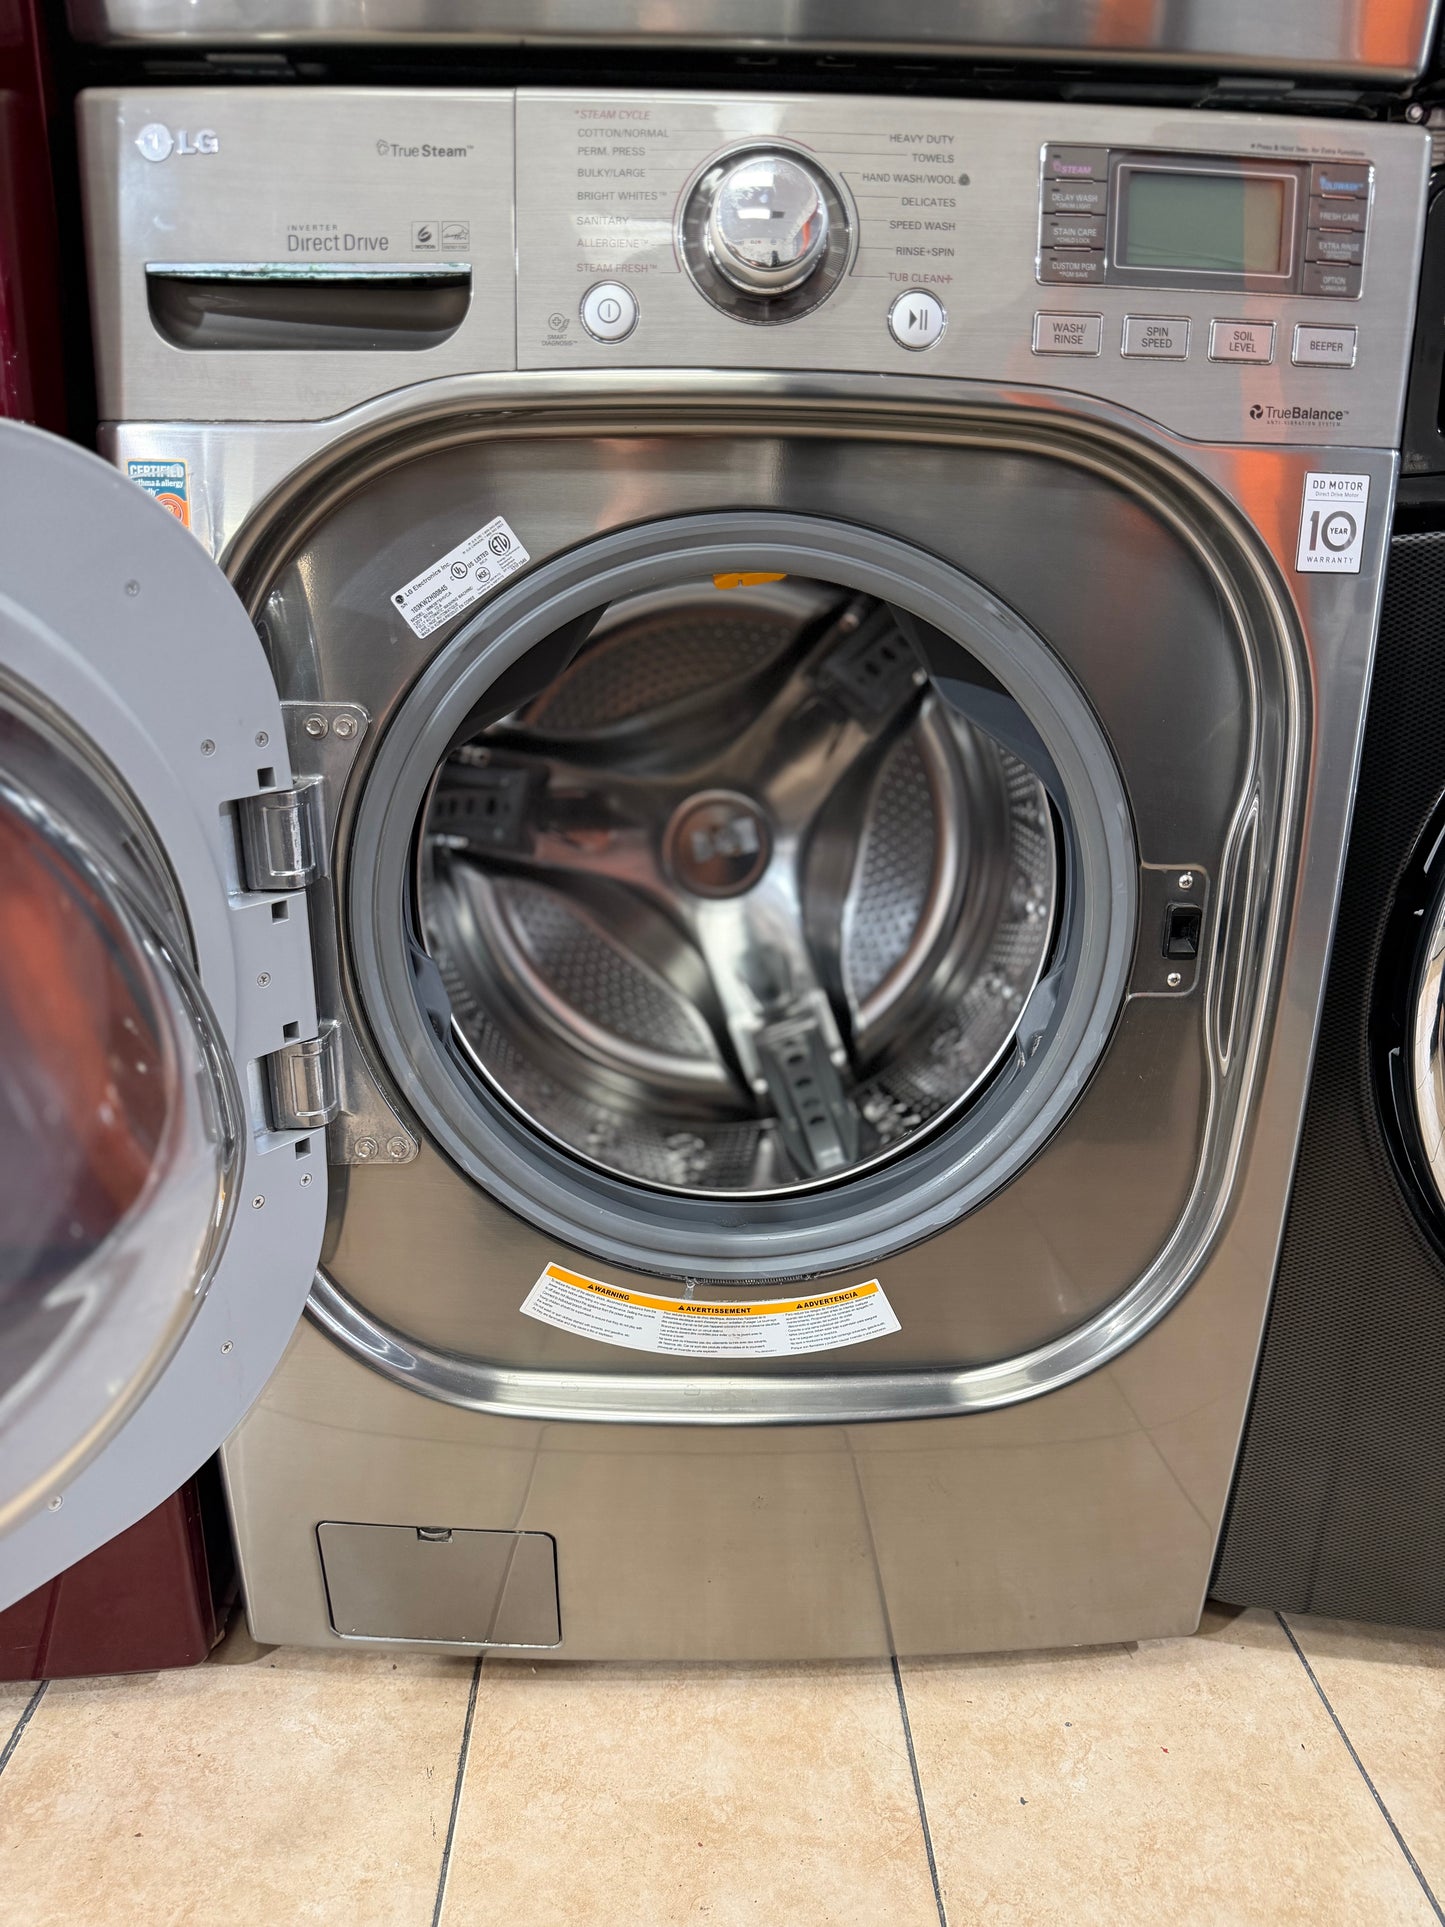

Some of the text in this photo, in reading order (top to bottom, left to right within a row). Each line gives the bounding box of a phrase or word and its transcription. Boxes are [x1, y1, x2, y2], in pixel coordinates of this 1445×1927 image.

[618, 110, 651, 120] CYCLE
[578, 128, 670, 138] COTTON/NORMAL
[178, 129, 219, 154] LG
[889, 134, 956, 144] HEAVY DUTY
[578, 146, 646, 156] PERM. PRESS
[912, 153, 955, 164] TOWELS
[577, 168, 646, 178] BULKY/LARGE
[862, 172, 956, 184] HAND WASH/WOOL
[577, 191, 616, 201] BRIGHT
[1052, 193, 1098, 202] DELAY WASH
[901, 197, 956, 208] DELICATES
[576, 216, 630, 225] SANITARY
[889, 220, 956, 231] SPEED WASH
[1054, 227, 1097, 237] STAIN CARE
[288, 234, 390, 251] Direct Drive
[896, 246, 955, 257] RINSE+SPIN
[576, 262, 612, 272] STEAM
[1052, 262, 1080, 270] CUSTOM
[888, 272, 909, 282] TUB
[1053, 322, 1086, 332] WASH/
[1146, 326, 1169, 336] SPIN
[1054, 334, 1084, 345] RINSE
[1233, 330, 1254, 342] SOIL
[1141, 338, 1172, 348] SPEED
[1229, 342, 1256, 353] LEVEL
[1310, 340, 1343, 352] BEEPER
[129, 464, 184, 478] CERTIFIED
[1313, 480, 1363, 490] DD MOTOR
[1309, 510, 1357, 552] 10
[1307, 556, 1354, 564] WARRANTY
[404, 588, 413, 597] LG
[412, 569, 441, 591] Electronics
[594, 1285, 630, 1300] WARNING
[804, 1292, 858, 1308] ADVERTENCIA
[686, 1306, 751, 1314] AVERTISSEMENT
